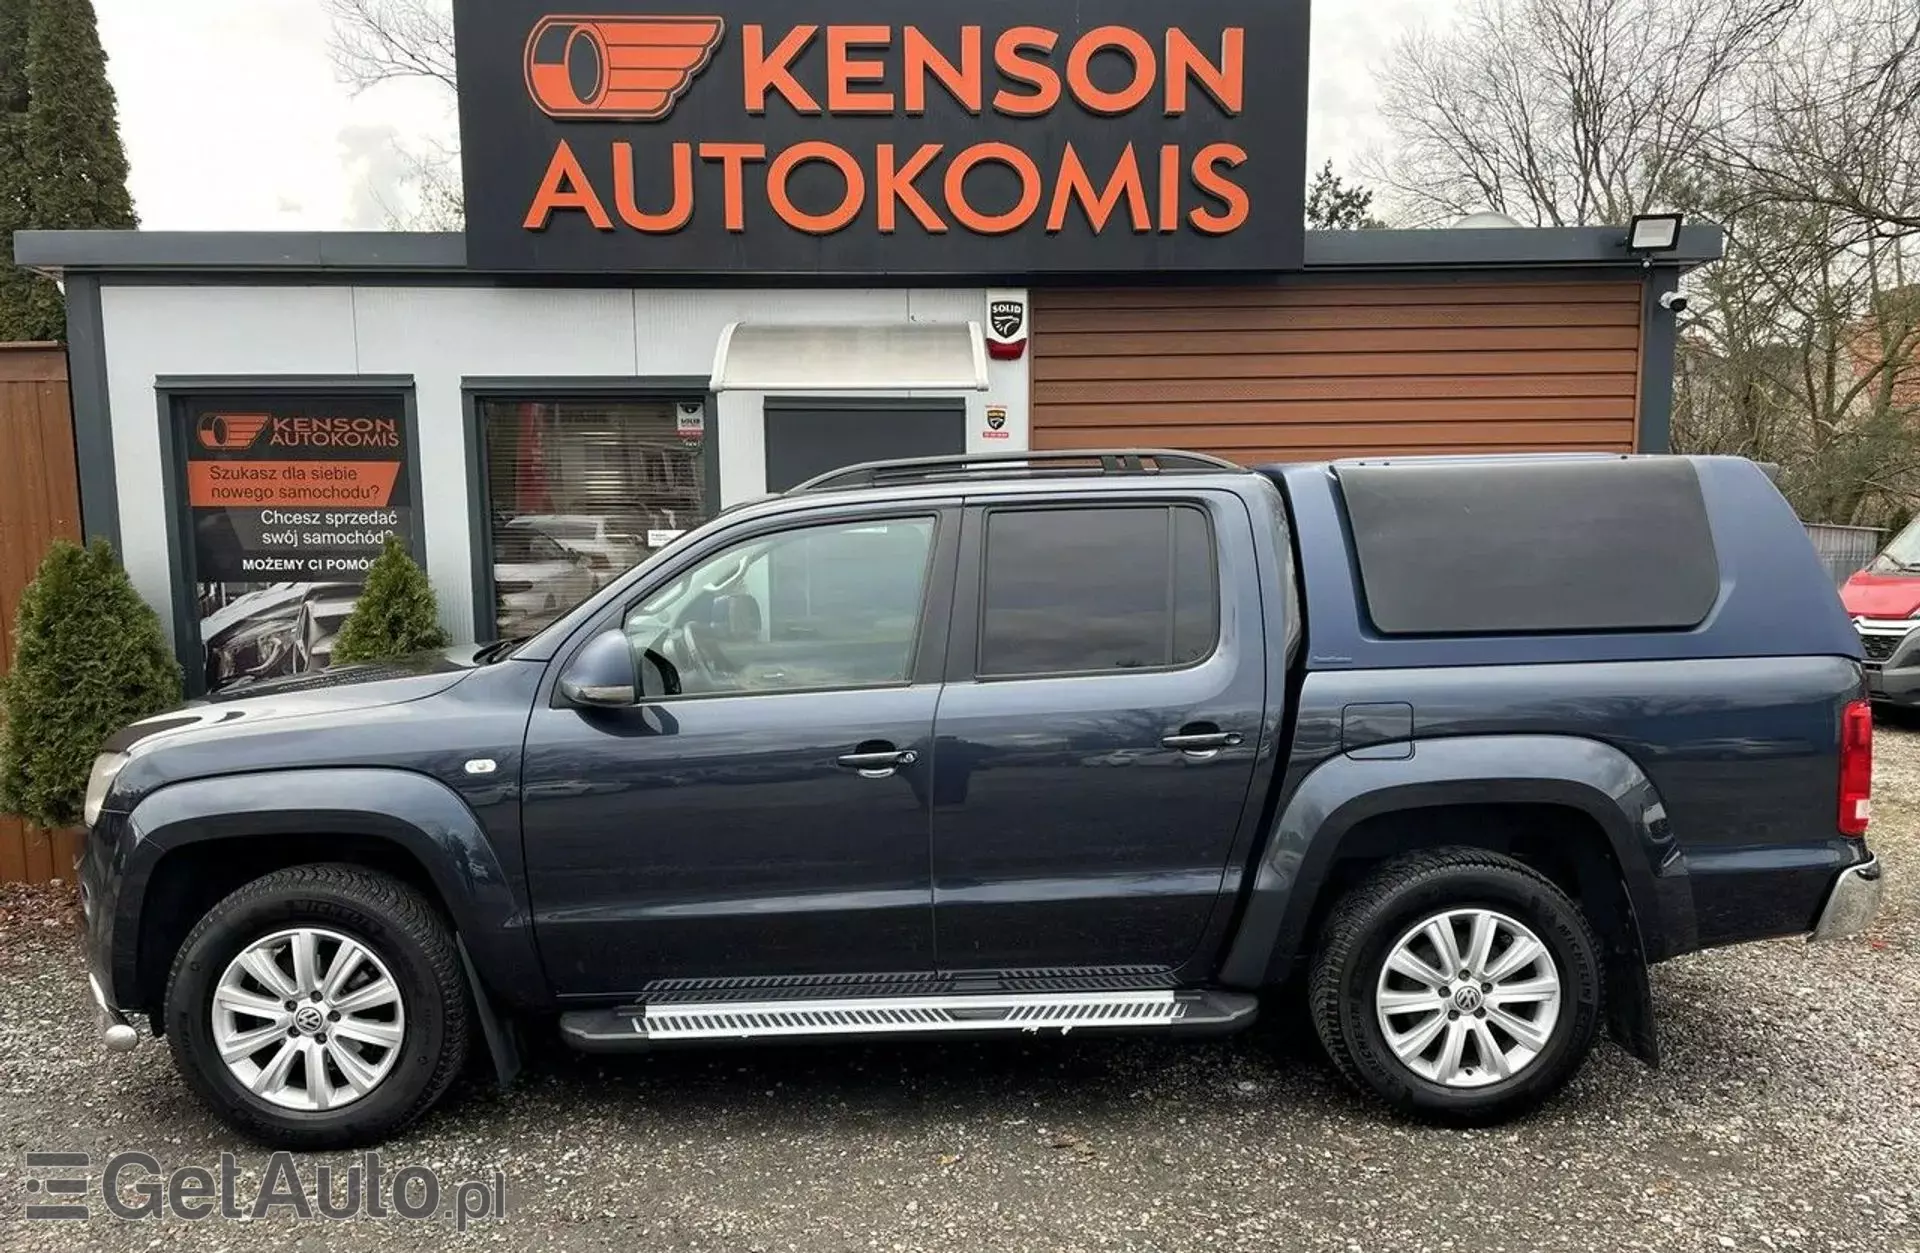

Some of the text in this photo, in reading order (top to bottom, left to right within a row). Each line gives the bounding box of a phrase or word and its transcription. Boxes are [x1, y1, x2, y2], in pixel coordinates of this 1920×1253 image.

[743, 24, 1244, 116] KENSON
[522, 139, 1250, 233] AUTOKOMIS
[992, 304, 1022, 314] SOLID
[273, 417, 396, 432] KENSON
[269, 431, 400, 447] AUTOKOMIS
[210, 465, 357, 481] Szukasz dla siebie
[211, 485, 380, 501] nowego samochodu?
[261, 510, 398, 529] Chcesz sprzedać
[262, 530, 298, 547] swój
[242, 557, 304, 571] MOŻEMY
[308, 559, 323, 571] CI
[1556, 922, 1592, 1001] MICHELIN
